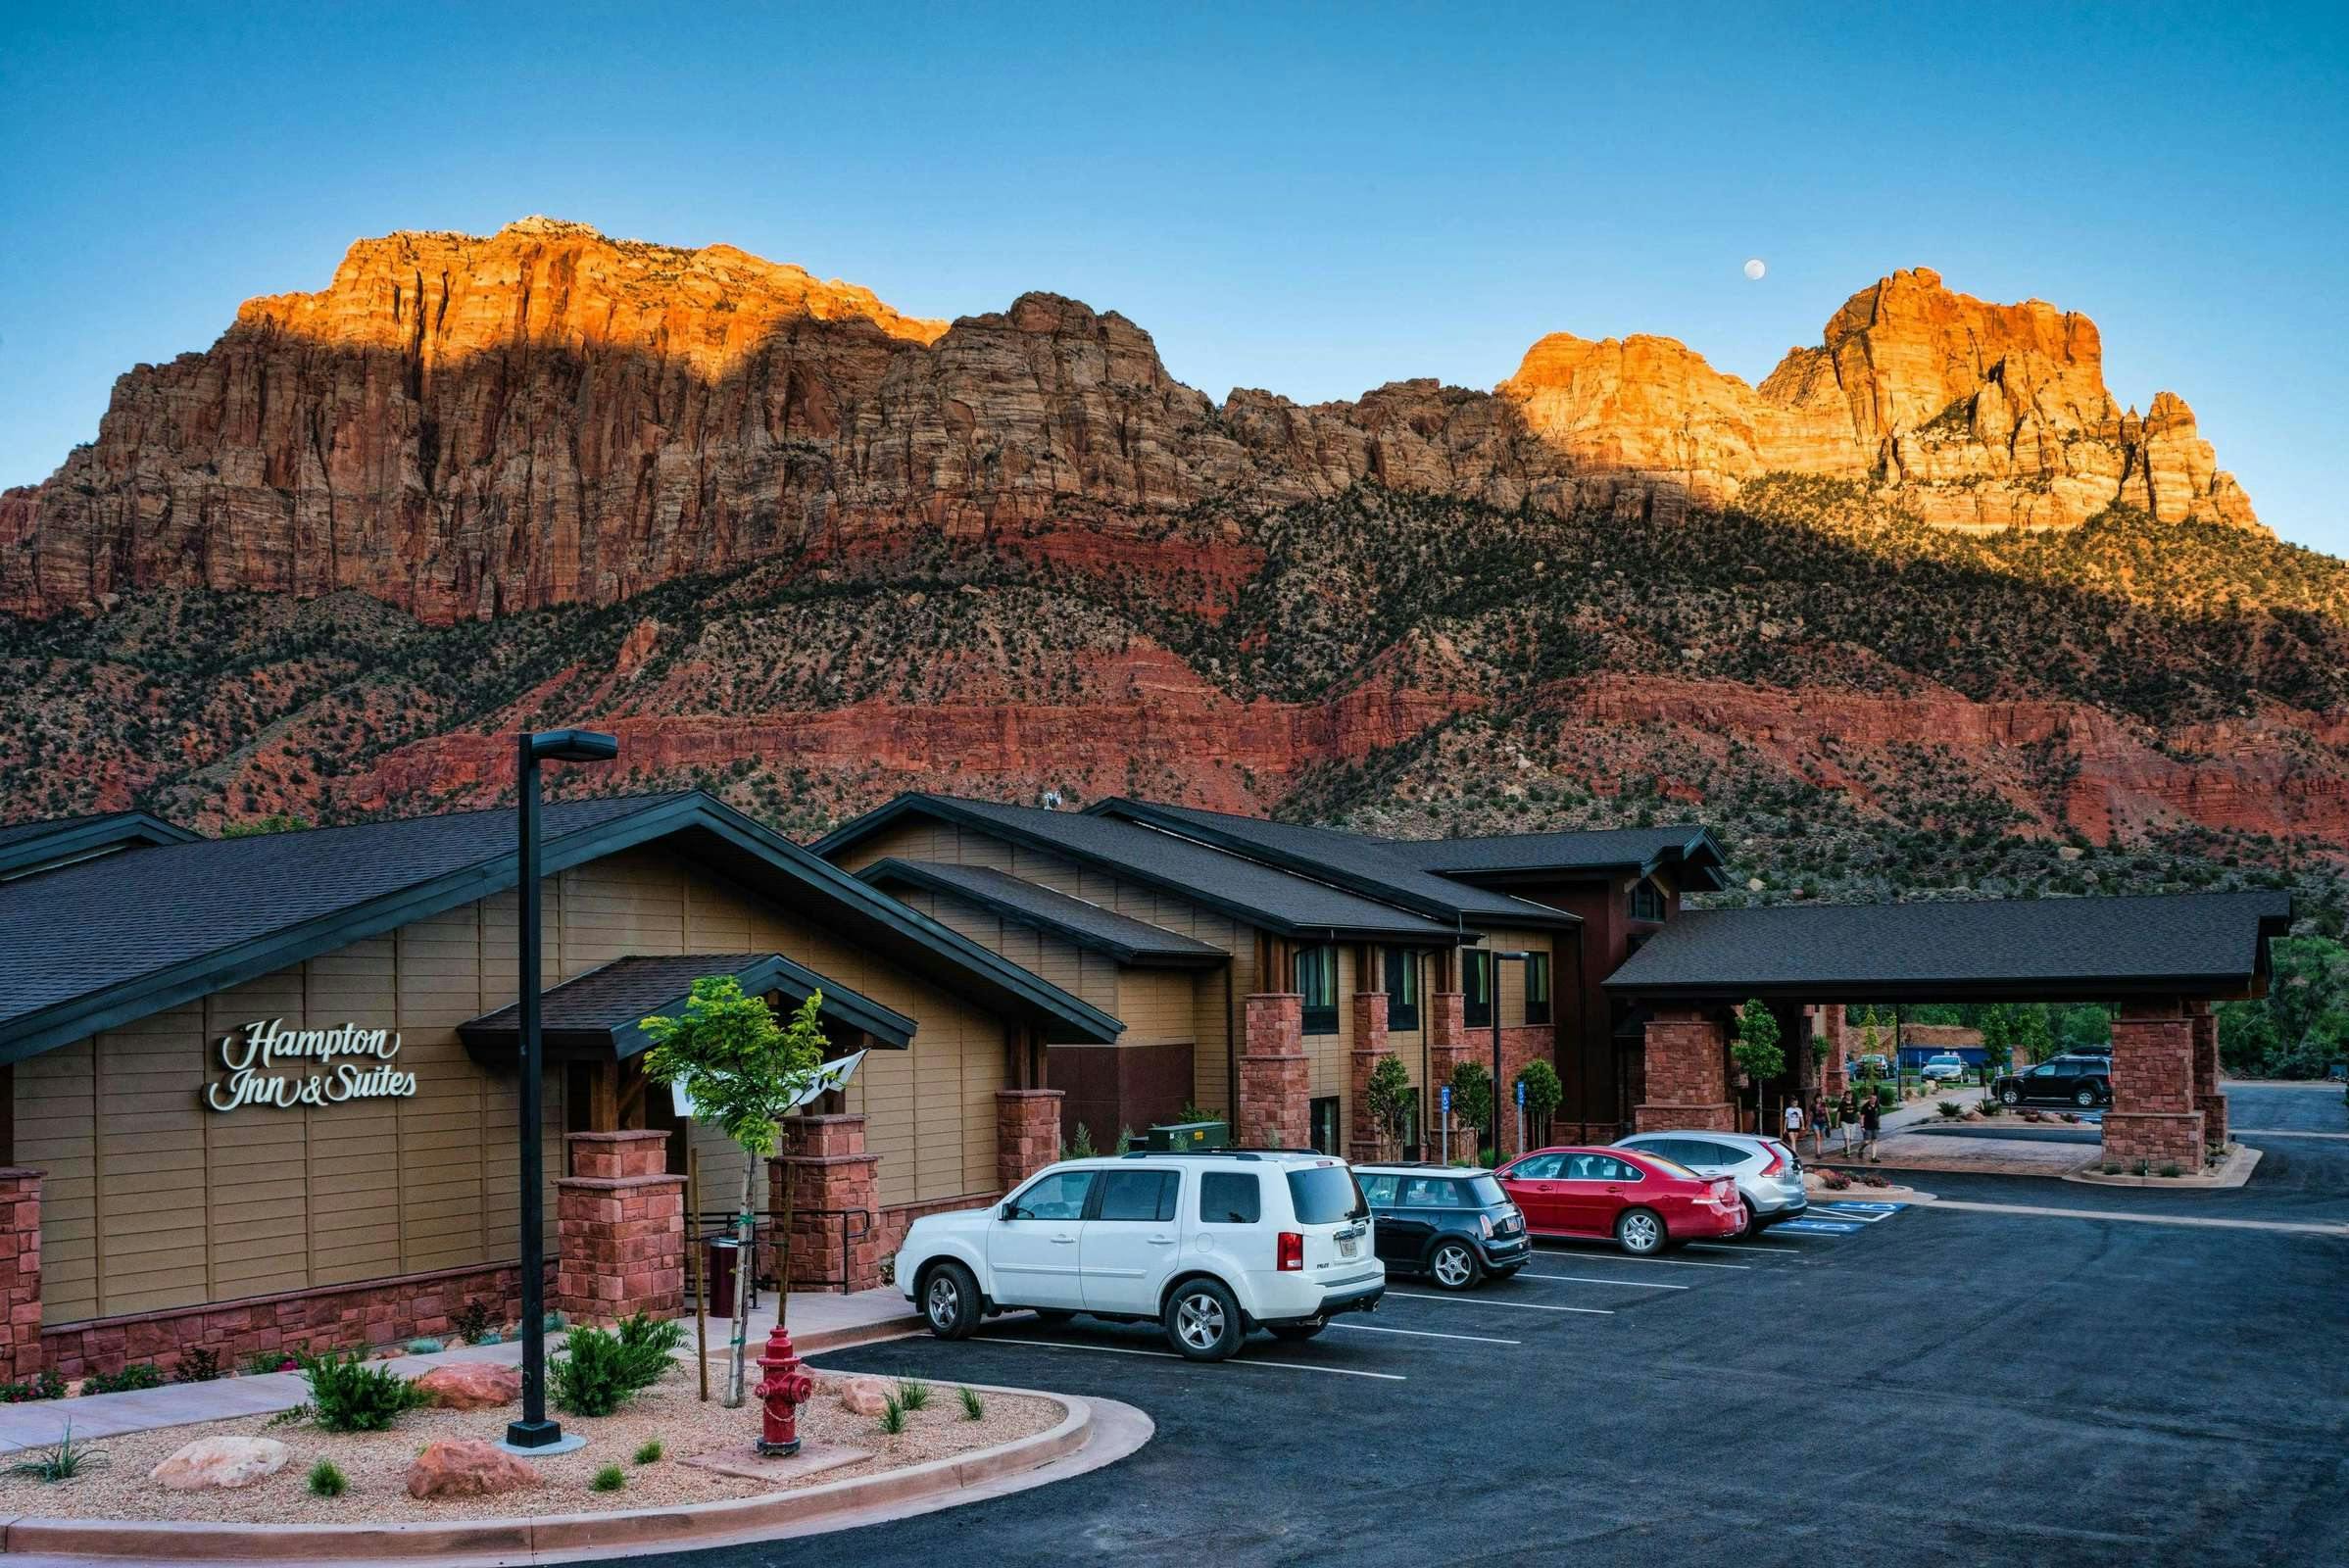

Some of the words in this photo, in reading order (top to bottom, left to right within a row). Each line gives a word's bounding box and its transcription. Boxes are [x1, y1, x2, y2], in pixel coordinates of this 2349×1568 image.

[221, 1017, 402, 1070] Hampton
[209, 1068, 302, 1111] Inn
[301, 1075, 328, 1106] &
[324, 1064, 417, 1102] Suites
